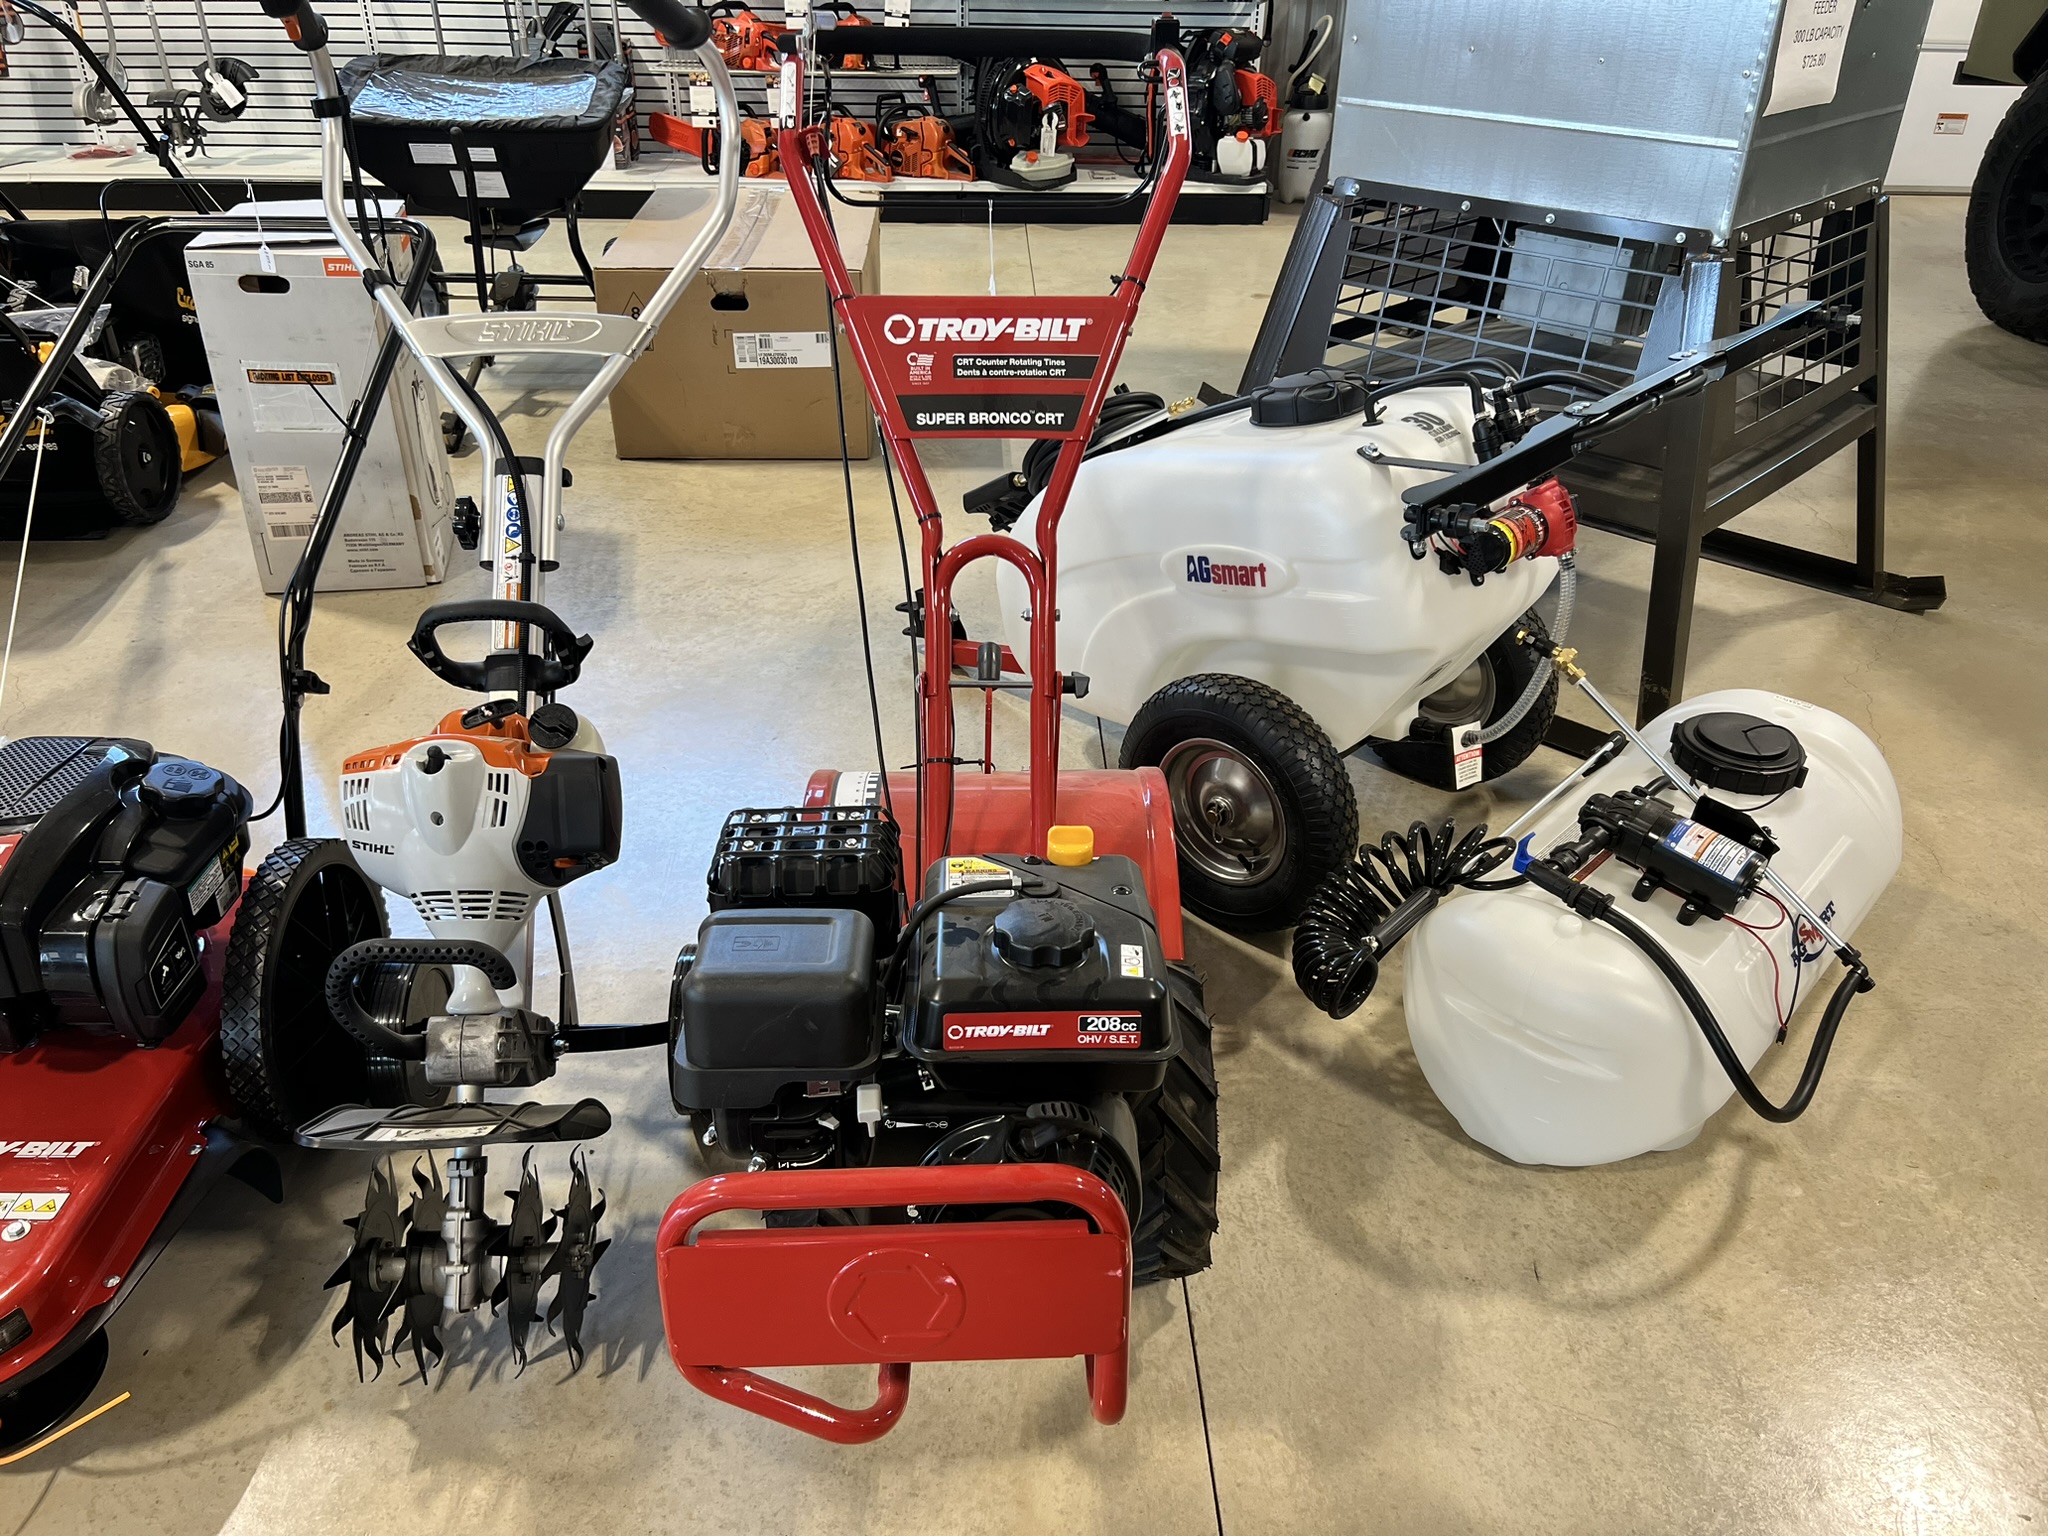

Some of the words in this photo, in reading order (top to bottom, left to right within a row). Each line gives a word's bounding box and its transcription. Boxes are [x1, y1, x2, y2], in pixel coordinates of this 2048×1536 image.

[1813, 0, 1838, 14] FEEDER
[1793, 30, 1806, 43] 300
[1806, 28, 1815, 42] LB
[1815, 25, 1845, 40] CAPACITY
[1802, 53, 1827, 69] $725.80
[188, 260, 204, 268] SGA
[205, 261, 214, 269] 85
[631, 306, 640, 320] 8
[478, 312, 572, 342] STIHL
[918, 317, 1086, 342] TROY-BILT
[957, 358, 974, 366] CRT
[976, 358, 1008, 366] Counter
[1009, 358, 1042, 367] Rotating
[1044, 358, 1066, 366] Tines
[281, 373, 295, 381] LIST
[916, 413, 965, 425] SUPER
[969, 412, 1031, 425] BRONCO
[1035, 412, 1064, 425] CRT
[1401, 412, 1445, 431] 30
[1187, 555, 1266, 587] AGsmart
[352, 840, 394, 855] STIHL
[965, 1024, 1051, 1038] TROY-BILT
[1087, 1017, 1137, 1031] 208cc
[1077, 1035, 1102, 1044] OHV
[1109, 1034, 1138, 1044] S.E.T.
